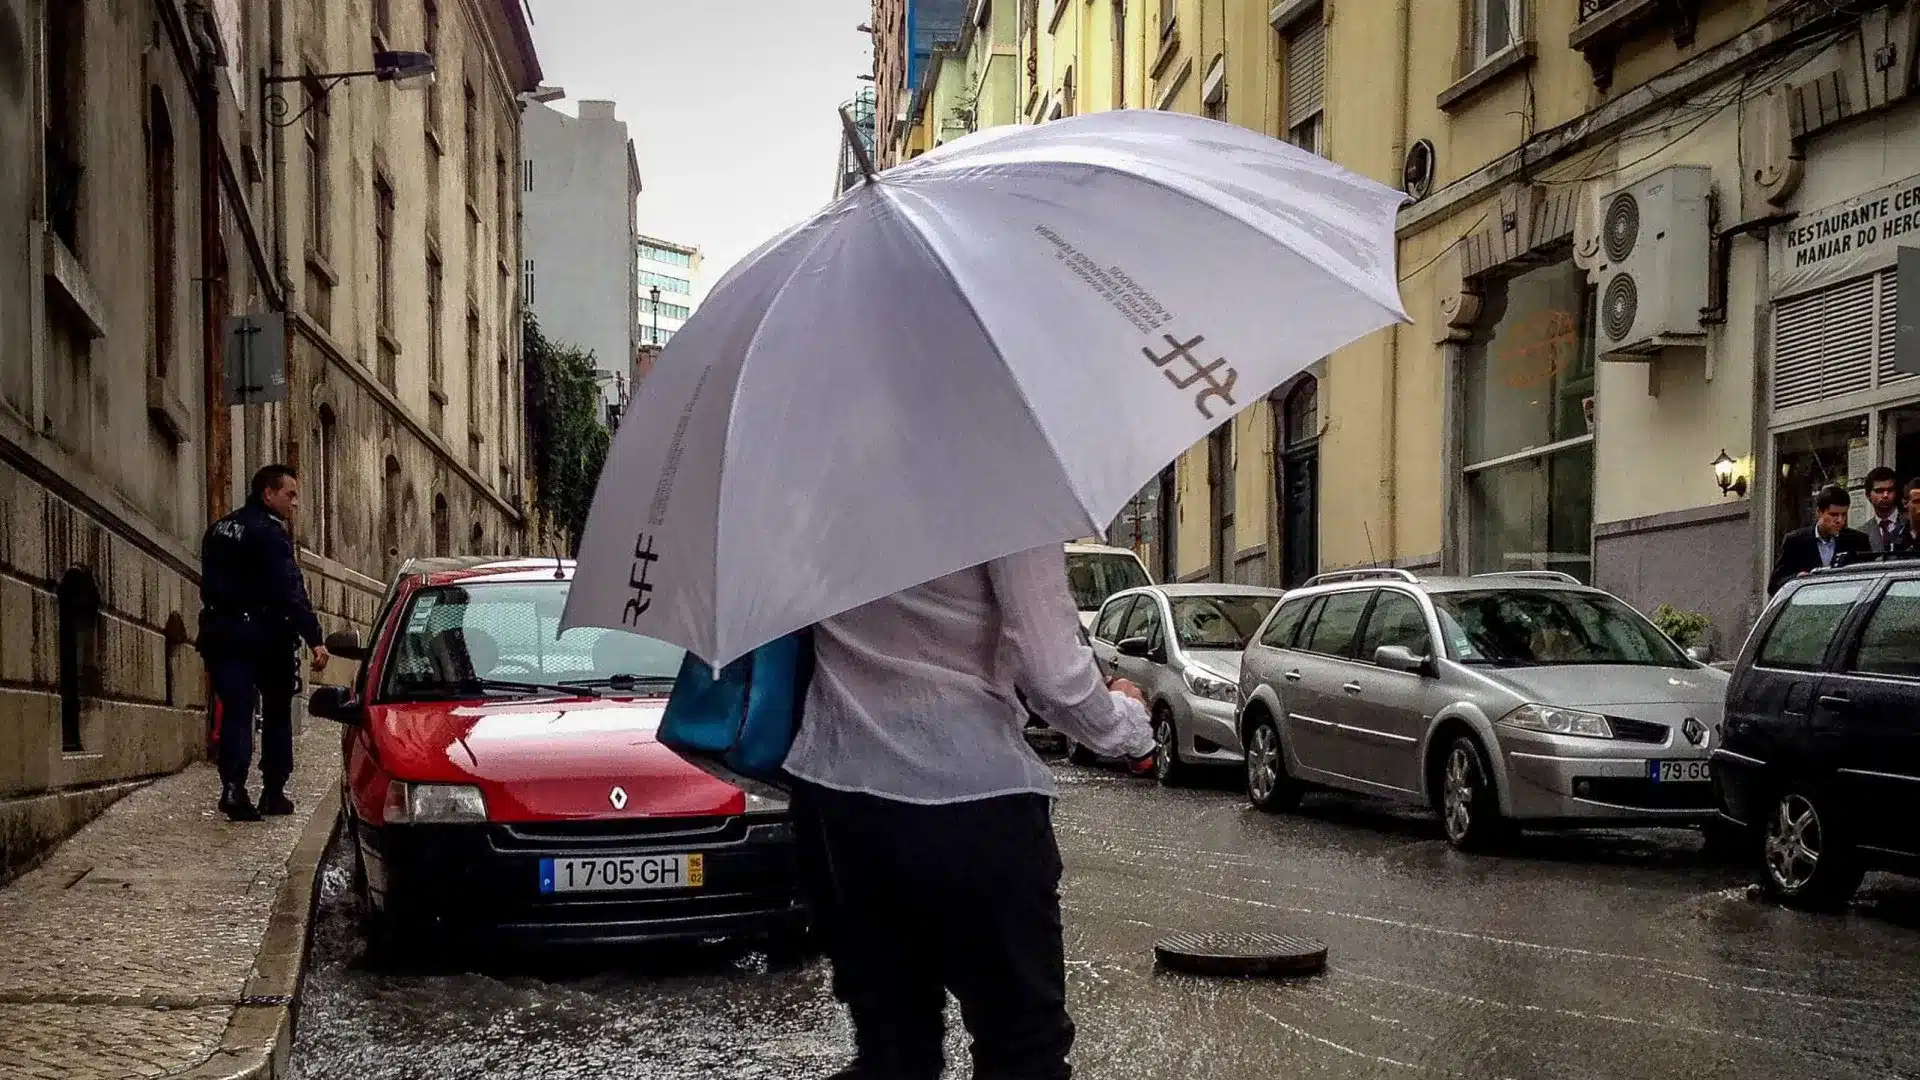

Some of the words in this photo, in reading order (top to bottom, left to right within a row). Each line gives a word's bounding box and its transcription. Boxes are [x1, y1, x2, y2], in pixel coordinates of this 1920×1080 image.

[1788, 197, 1890, 249] RESTAURANTE
[1796, 234, 1852, 268] MANJAR
[1857, 226, 1877, 248] DO
[622, 532, 659, 628] RFF
